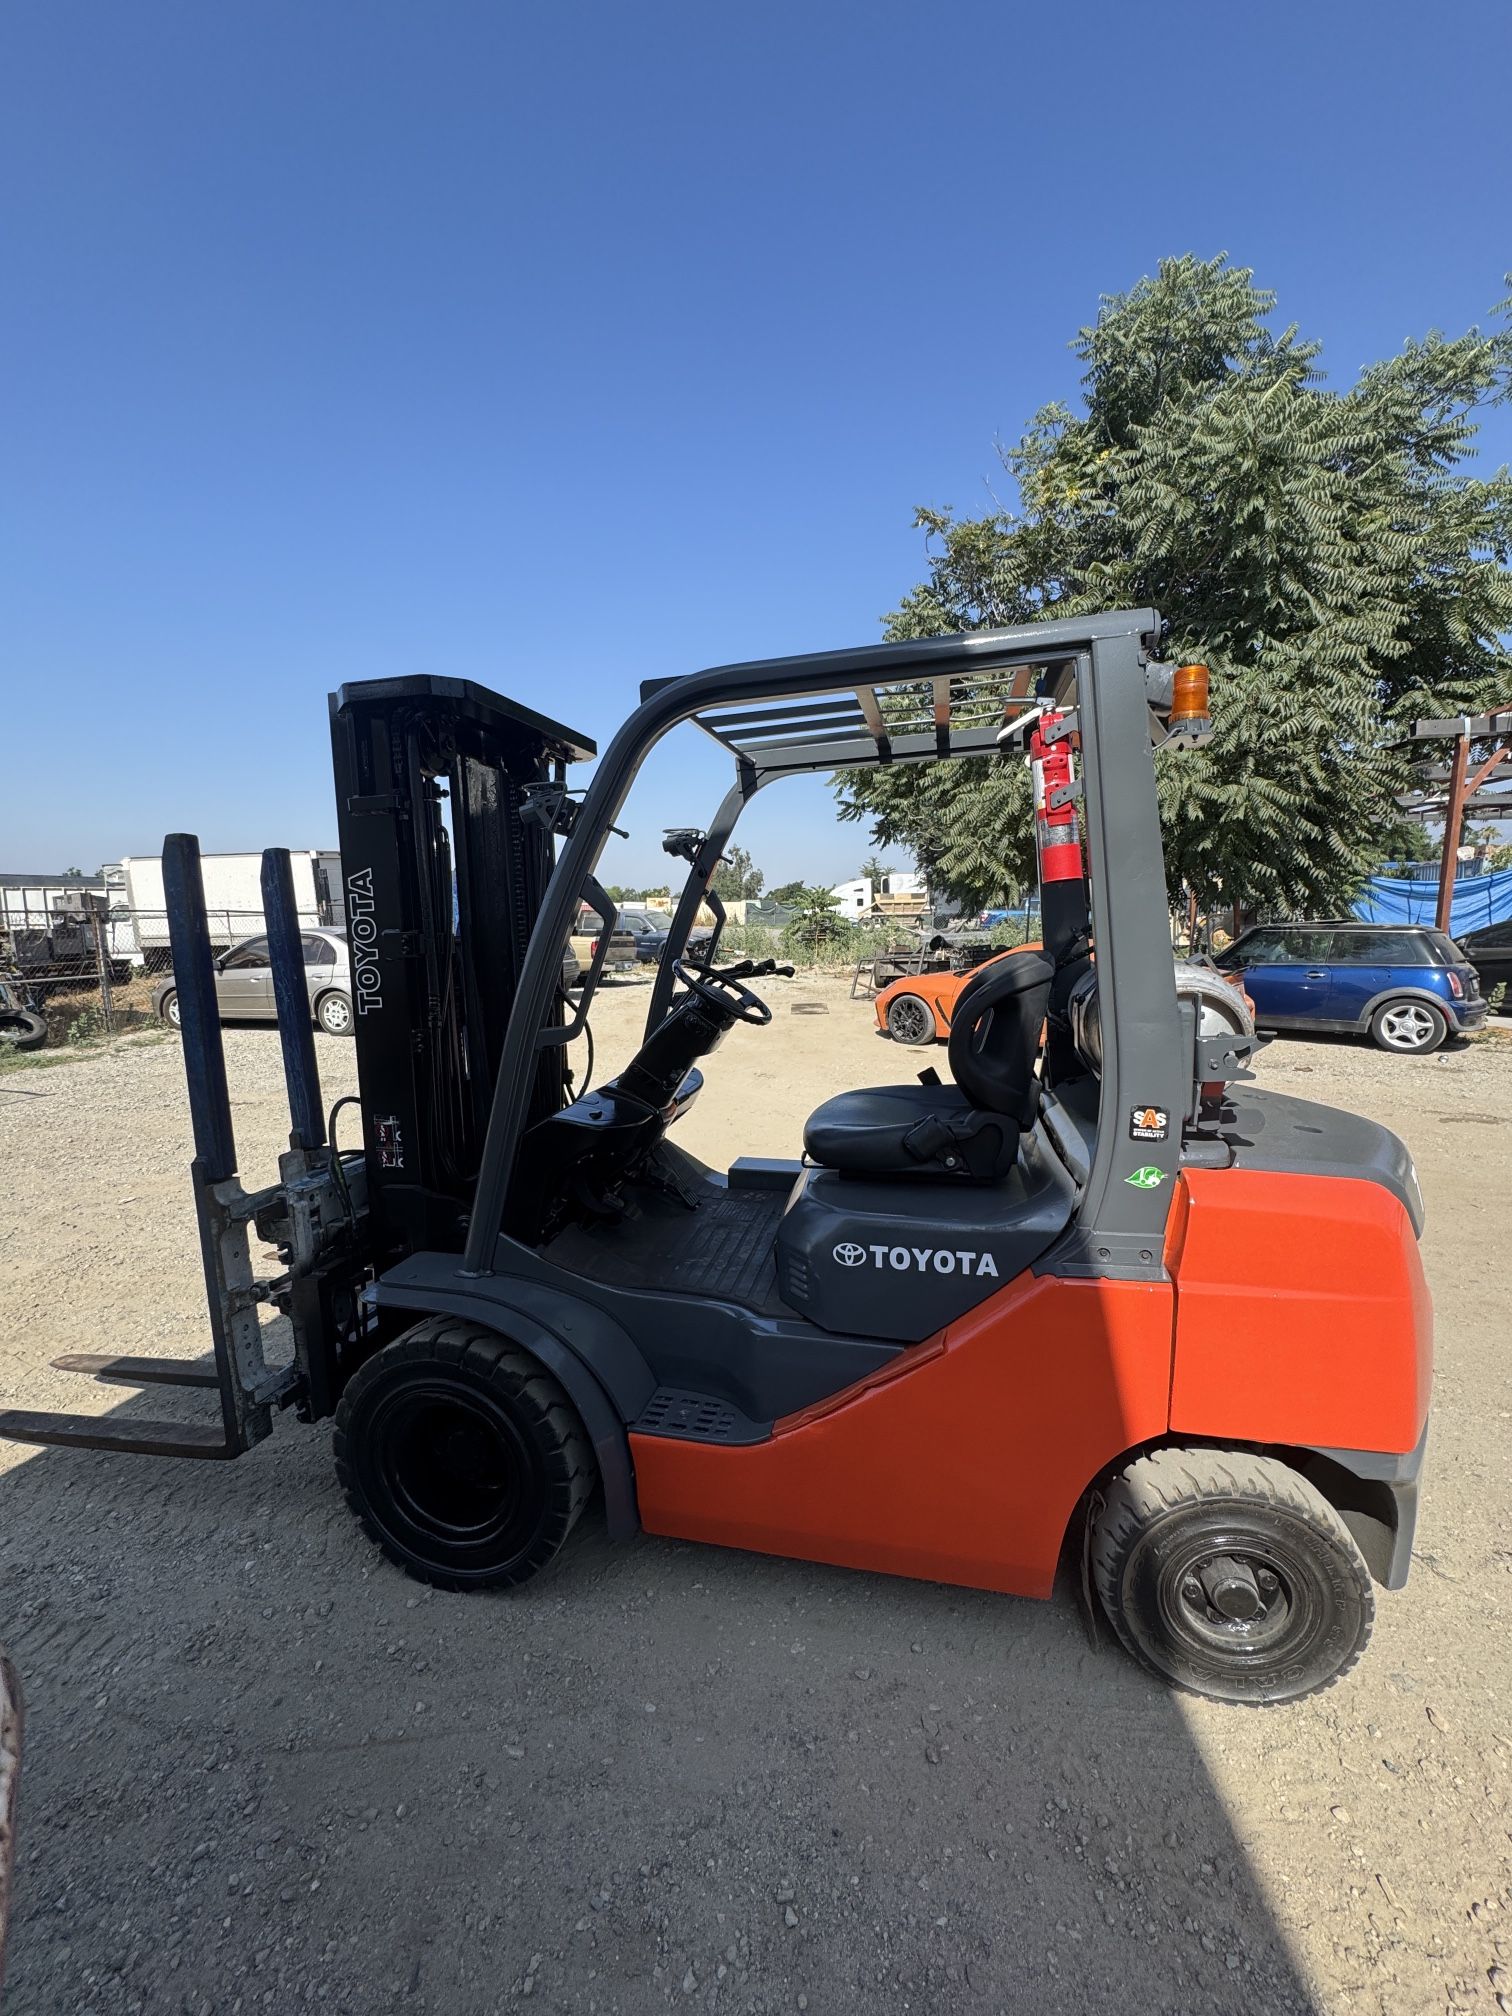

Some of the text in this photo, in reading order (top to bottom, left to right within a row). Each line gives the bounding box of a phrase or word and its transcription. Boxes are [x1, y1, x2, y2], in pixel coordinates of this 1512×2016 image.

[348, 868, 383, 1015] TOYOTA
[1133, 1109, 1166, 1128] SAS
[869, 1245, 999, 1277] TOYOTA
